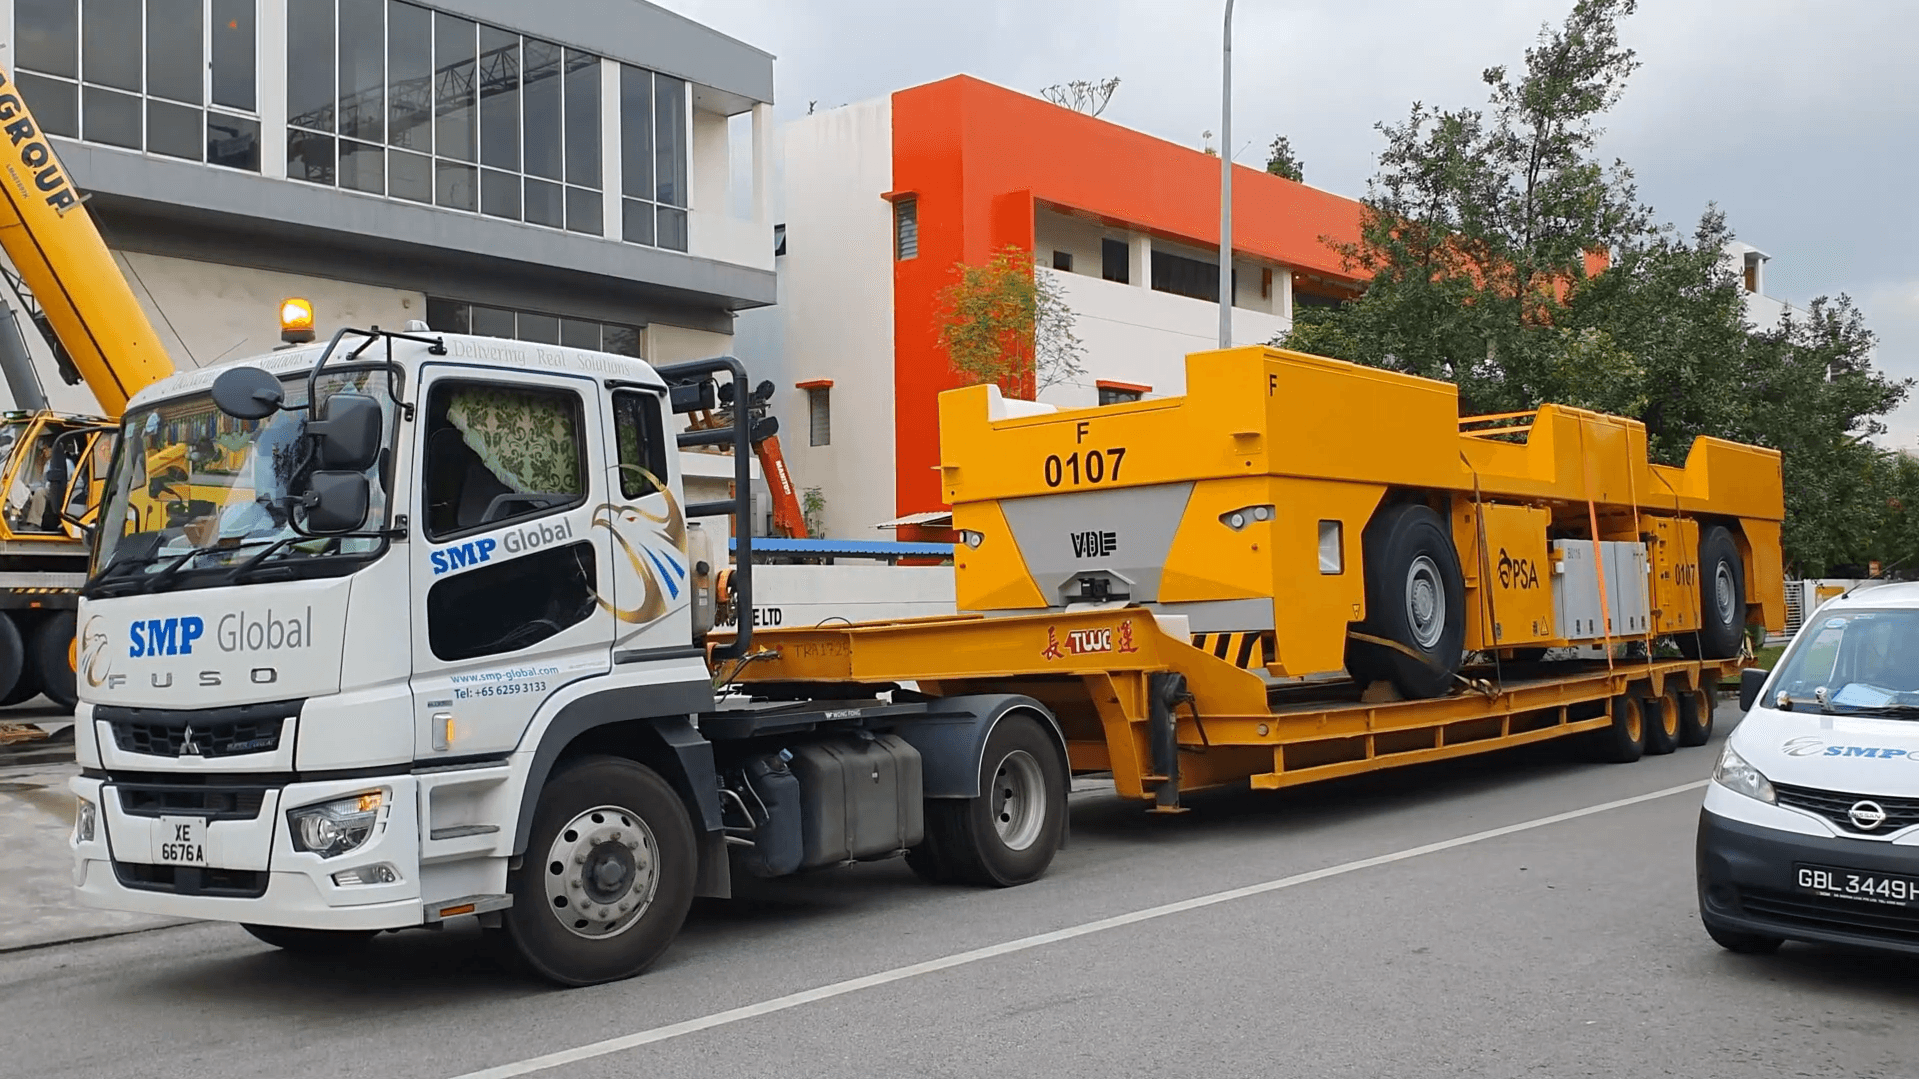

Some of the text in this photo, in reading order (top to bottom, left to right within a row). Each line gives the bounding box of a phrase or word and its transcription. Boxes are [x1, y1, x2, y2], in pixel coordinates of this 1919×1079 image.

[537, 349, 566, 367] Real
[1268, 374, 1277, 397] F
[1076, 422, 1090, 444] F
[1044, 448, 1127, 488] 0107
[430, 517, 573, 575] SMP Global
[1513, 560, 1539, 590] PSA
[1675, 563, 1696, 587] 0107
[129, 605, 312, 658] SMP Global
[108, 667, 278, 690] FUSO
[451, 666, 559, 683] www.smp-global.com
[475, 686, 494, 697] +65
[496, 683, 521, 696] 6259
[522, 681, 547, 693] 3133
[1823, 746, 1907, 759] SMP
[1851, 811, 1881, 819] NISSAN
[175, 824, 191, 842] XE
[162, 844, 204, 863] 6676A
[1799, 869, 1842, 891] GBL
